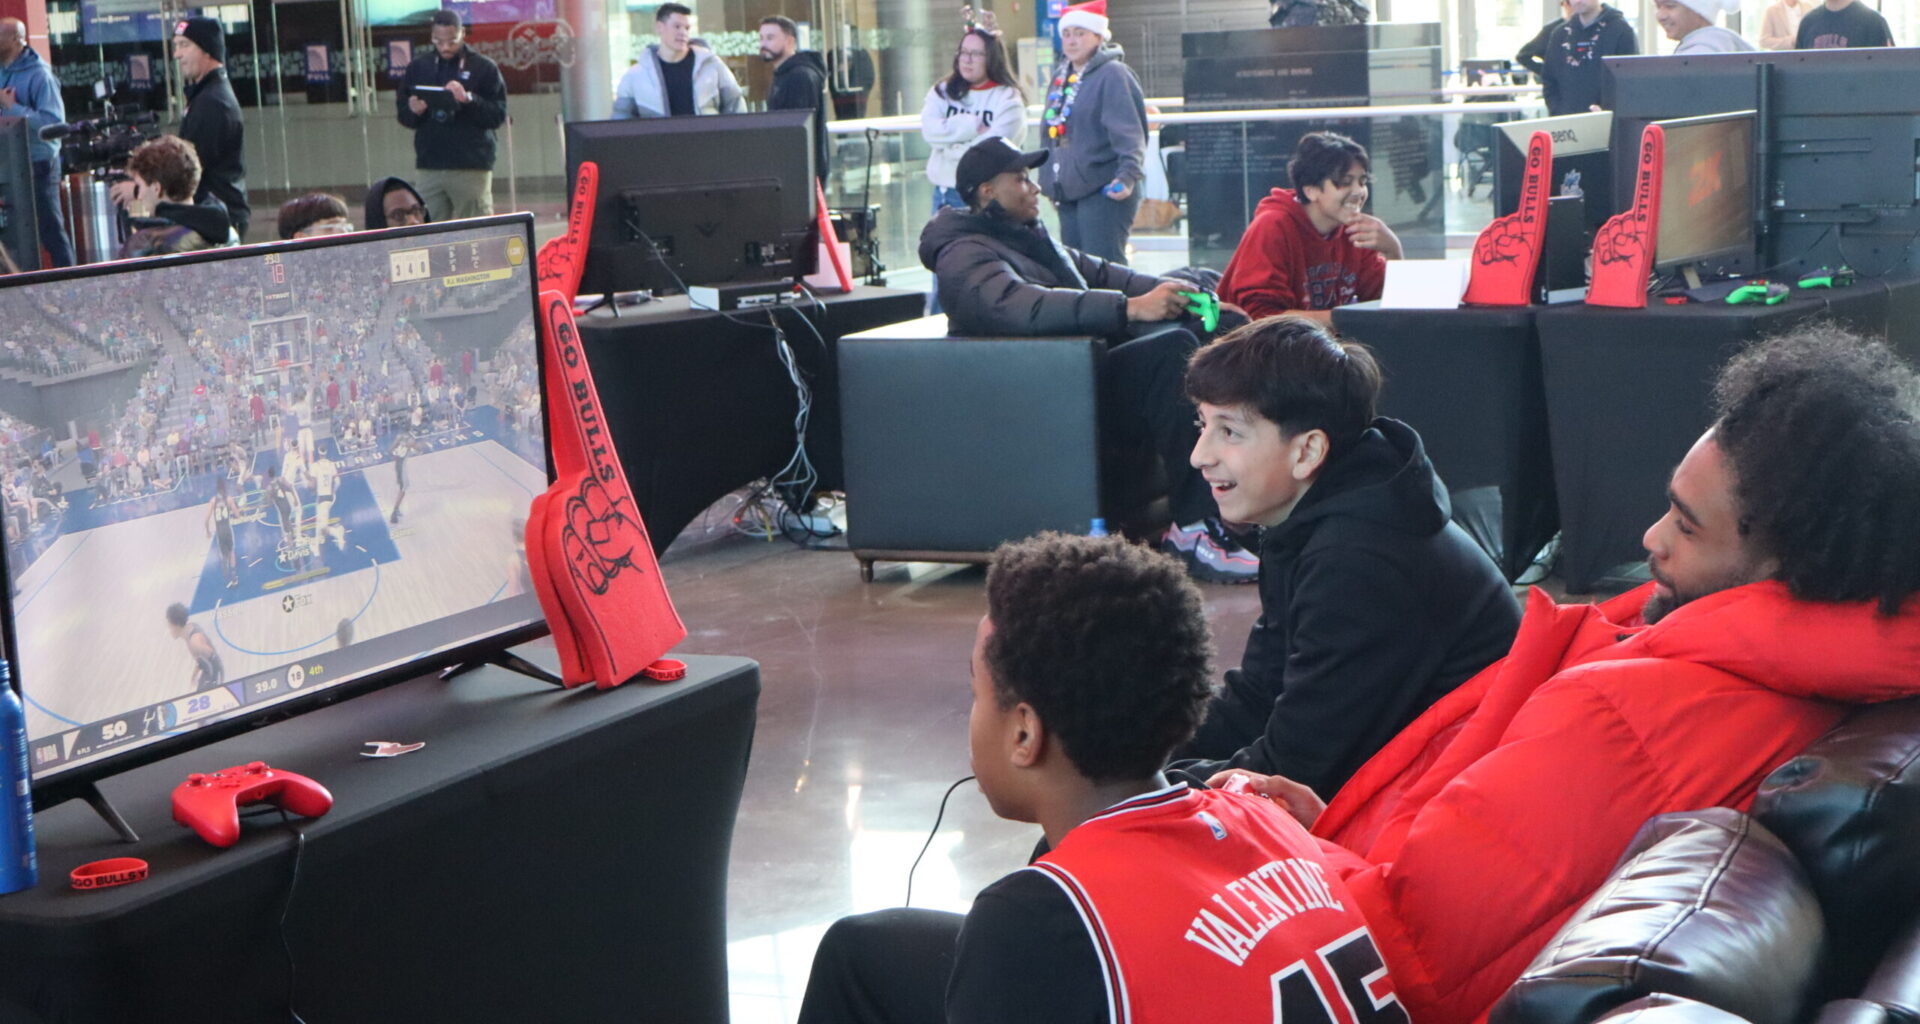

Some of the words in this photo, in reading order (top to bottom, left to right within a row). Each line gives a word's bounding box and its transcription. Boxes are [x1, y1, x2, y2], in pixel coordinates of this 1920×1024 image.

[1530, 147, 1541, 168] GO
[1644, 142, 1653, 164] GO
[1523, 174, 1538, 223] BULLS
[1637, 171, 1651, 222] BULLS
[569, 202, 584, 244] BULLS
[558, 322, 578, 368] GO
[572, 379, 616, 483] BULLS
[309, 664, 323, 675] 4th
[255, 678, 278, 694] 39.0
[187, 695, 210, 714] 28
[102, 720, 128, 740] 50
[96, 871, 136, 886] BULLS
[1184, 857, 1345, 967] VALENTINE
